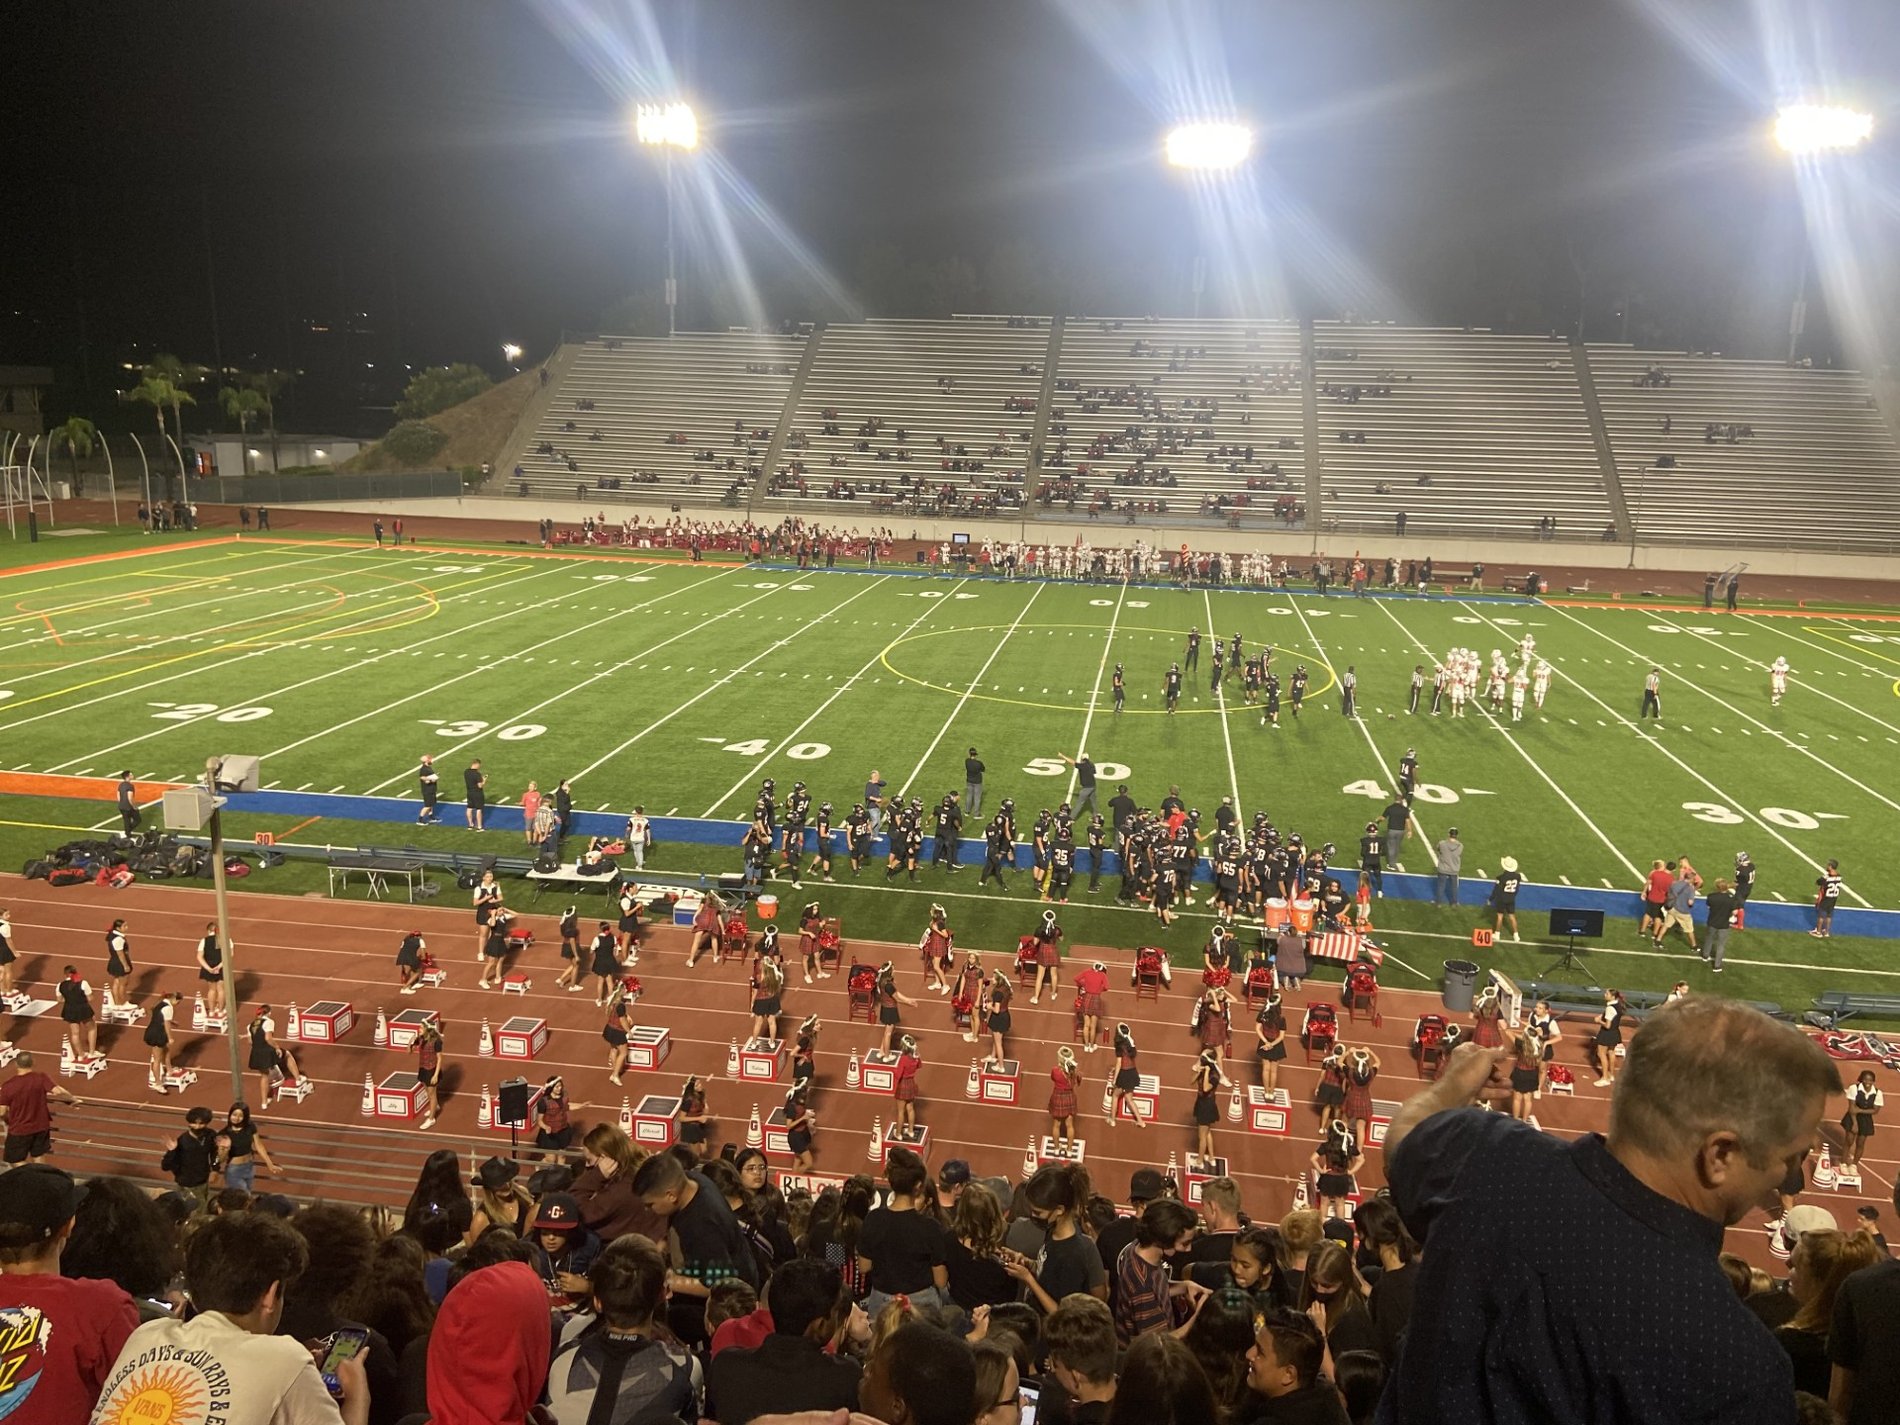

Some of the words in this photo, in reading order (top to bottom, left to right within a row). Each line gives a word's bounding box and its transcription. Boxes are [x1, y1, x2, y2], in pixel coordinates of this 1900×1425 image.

[151, 703, 273, 722] 20
[435, 720, 547, 741] 30
[723, 739, 832, 760] 40
[1022, 758, 1132, 781] 50
[1342, 779, 1460, 804] 40
[940, 813, 948, 825] 5
[1682, 802, 1820, 830] 30
[257, 833, 270, 845] 30
[1054, 848, 1069, 861] 35
[1173, 845, 1187, 859] 77
[1368, 842, 1378, 855] 11
[1222, 861, 1237, 877] 65
[1503, 879, 1518, 894] 22
[1825, 883, 1840, 898] 26
[1476, 932, 1491, 944] 40
[551, 1205, 560, 1219] G
[138, 1344, 175, 1368] DAYS
[172, 1348, 186, 1361] &
[183, 1349, 214, 1371] SUN
[202, 1362, 231, 1398] RAYS
[132, 1398, 167, 1420] VANS
[209, 1400, 230, 1412] &
